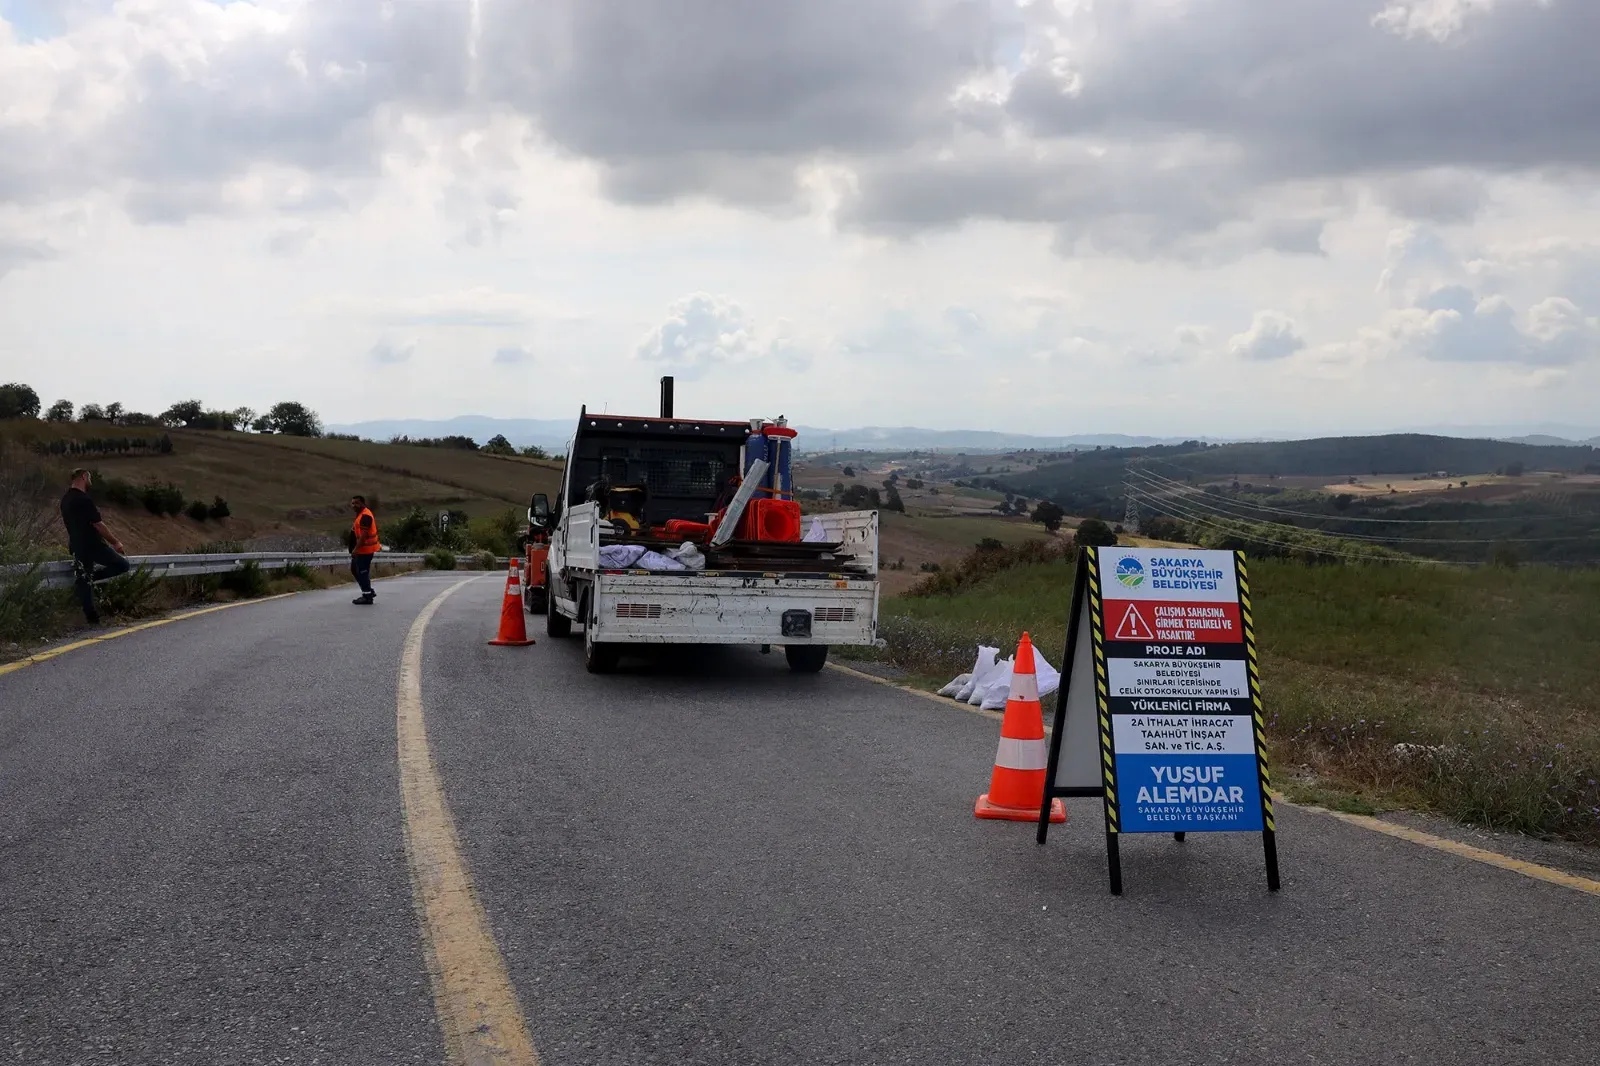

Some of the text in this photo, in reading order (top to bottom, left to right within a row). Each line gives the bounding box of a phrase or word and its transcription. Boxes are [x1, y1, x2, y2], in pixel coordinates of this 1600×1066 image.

[1151, 558, 1204, 567] SAKARYA
[1152, 568, 1222, 579] BÜYÜKŞEHİR
[1153, 580, 1217, 590] BELEDİYESİ
[1154, 607, 1224, 619] ÇALIŞMA SAHASINA
[1156, 618, 1232, 629] GİRMEK TEHLİKELİ VE
[1157, 630, 1195, 640] YASAKTIR!
[1146, 646, 1206, 655] PROJE ADI
[1172, 661, 1221, 669] BÜYÜKŞEHİR
[1178, 679, 1221, 687] İÇERİSİNDE
[1131, 699, 1231, 711] YÜKLENİCİ FİRMA
[1147, 718, 1188, 726] İTHALAT
[1192, 718, 1234, 727] İHRACAT
[1142, 729, 1226, 740] TAAHHÜT İNŞAAT
[1185, 741, 1203, 750] TİC.
[1207, 742, 1224, 752] A.Ş.
[1151, 767, 1224, 783] YUSUF
[1136, 787, 1244, 803] ALEMDAR
[1186, 806, 1244, 814] BÜYÜKŞEHİR
